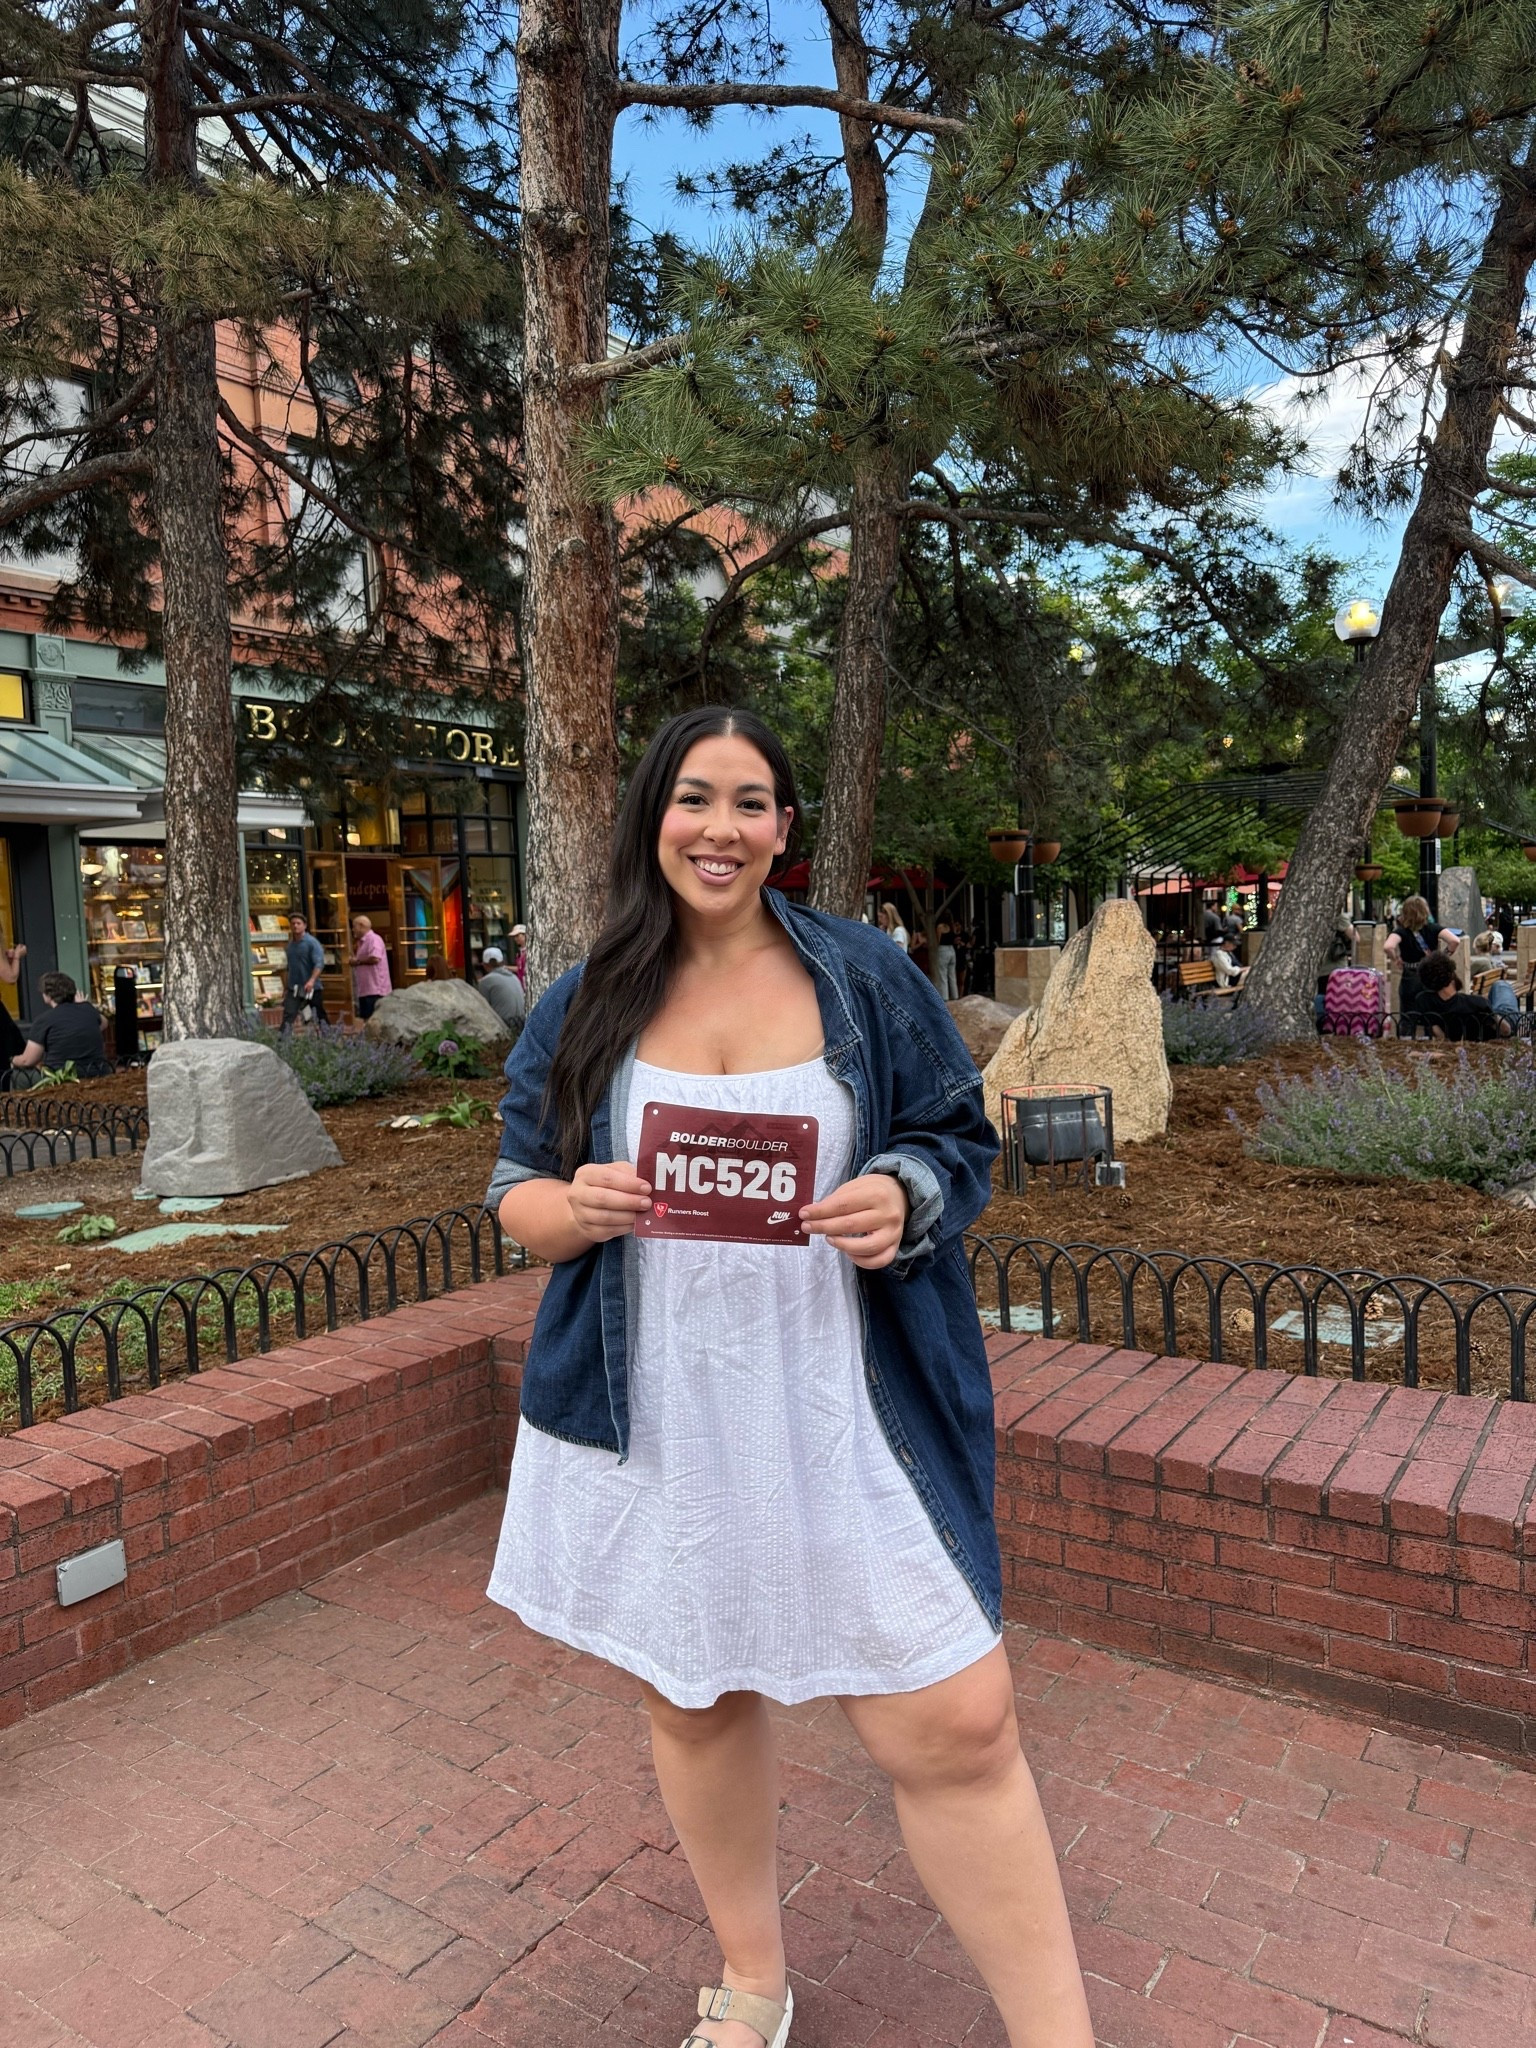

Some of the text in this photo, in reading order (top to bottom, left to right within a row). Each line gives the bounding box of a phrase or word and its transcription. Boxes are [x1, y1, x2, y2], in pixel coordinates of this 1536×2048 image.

[654, 1152, 797, 1202] MC526
[667, 1207, 709, 1217] Runners Roost
[771, 1211, 791, 1220] RUN
